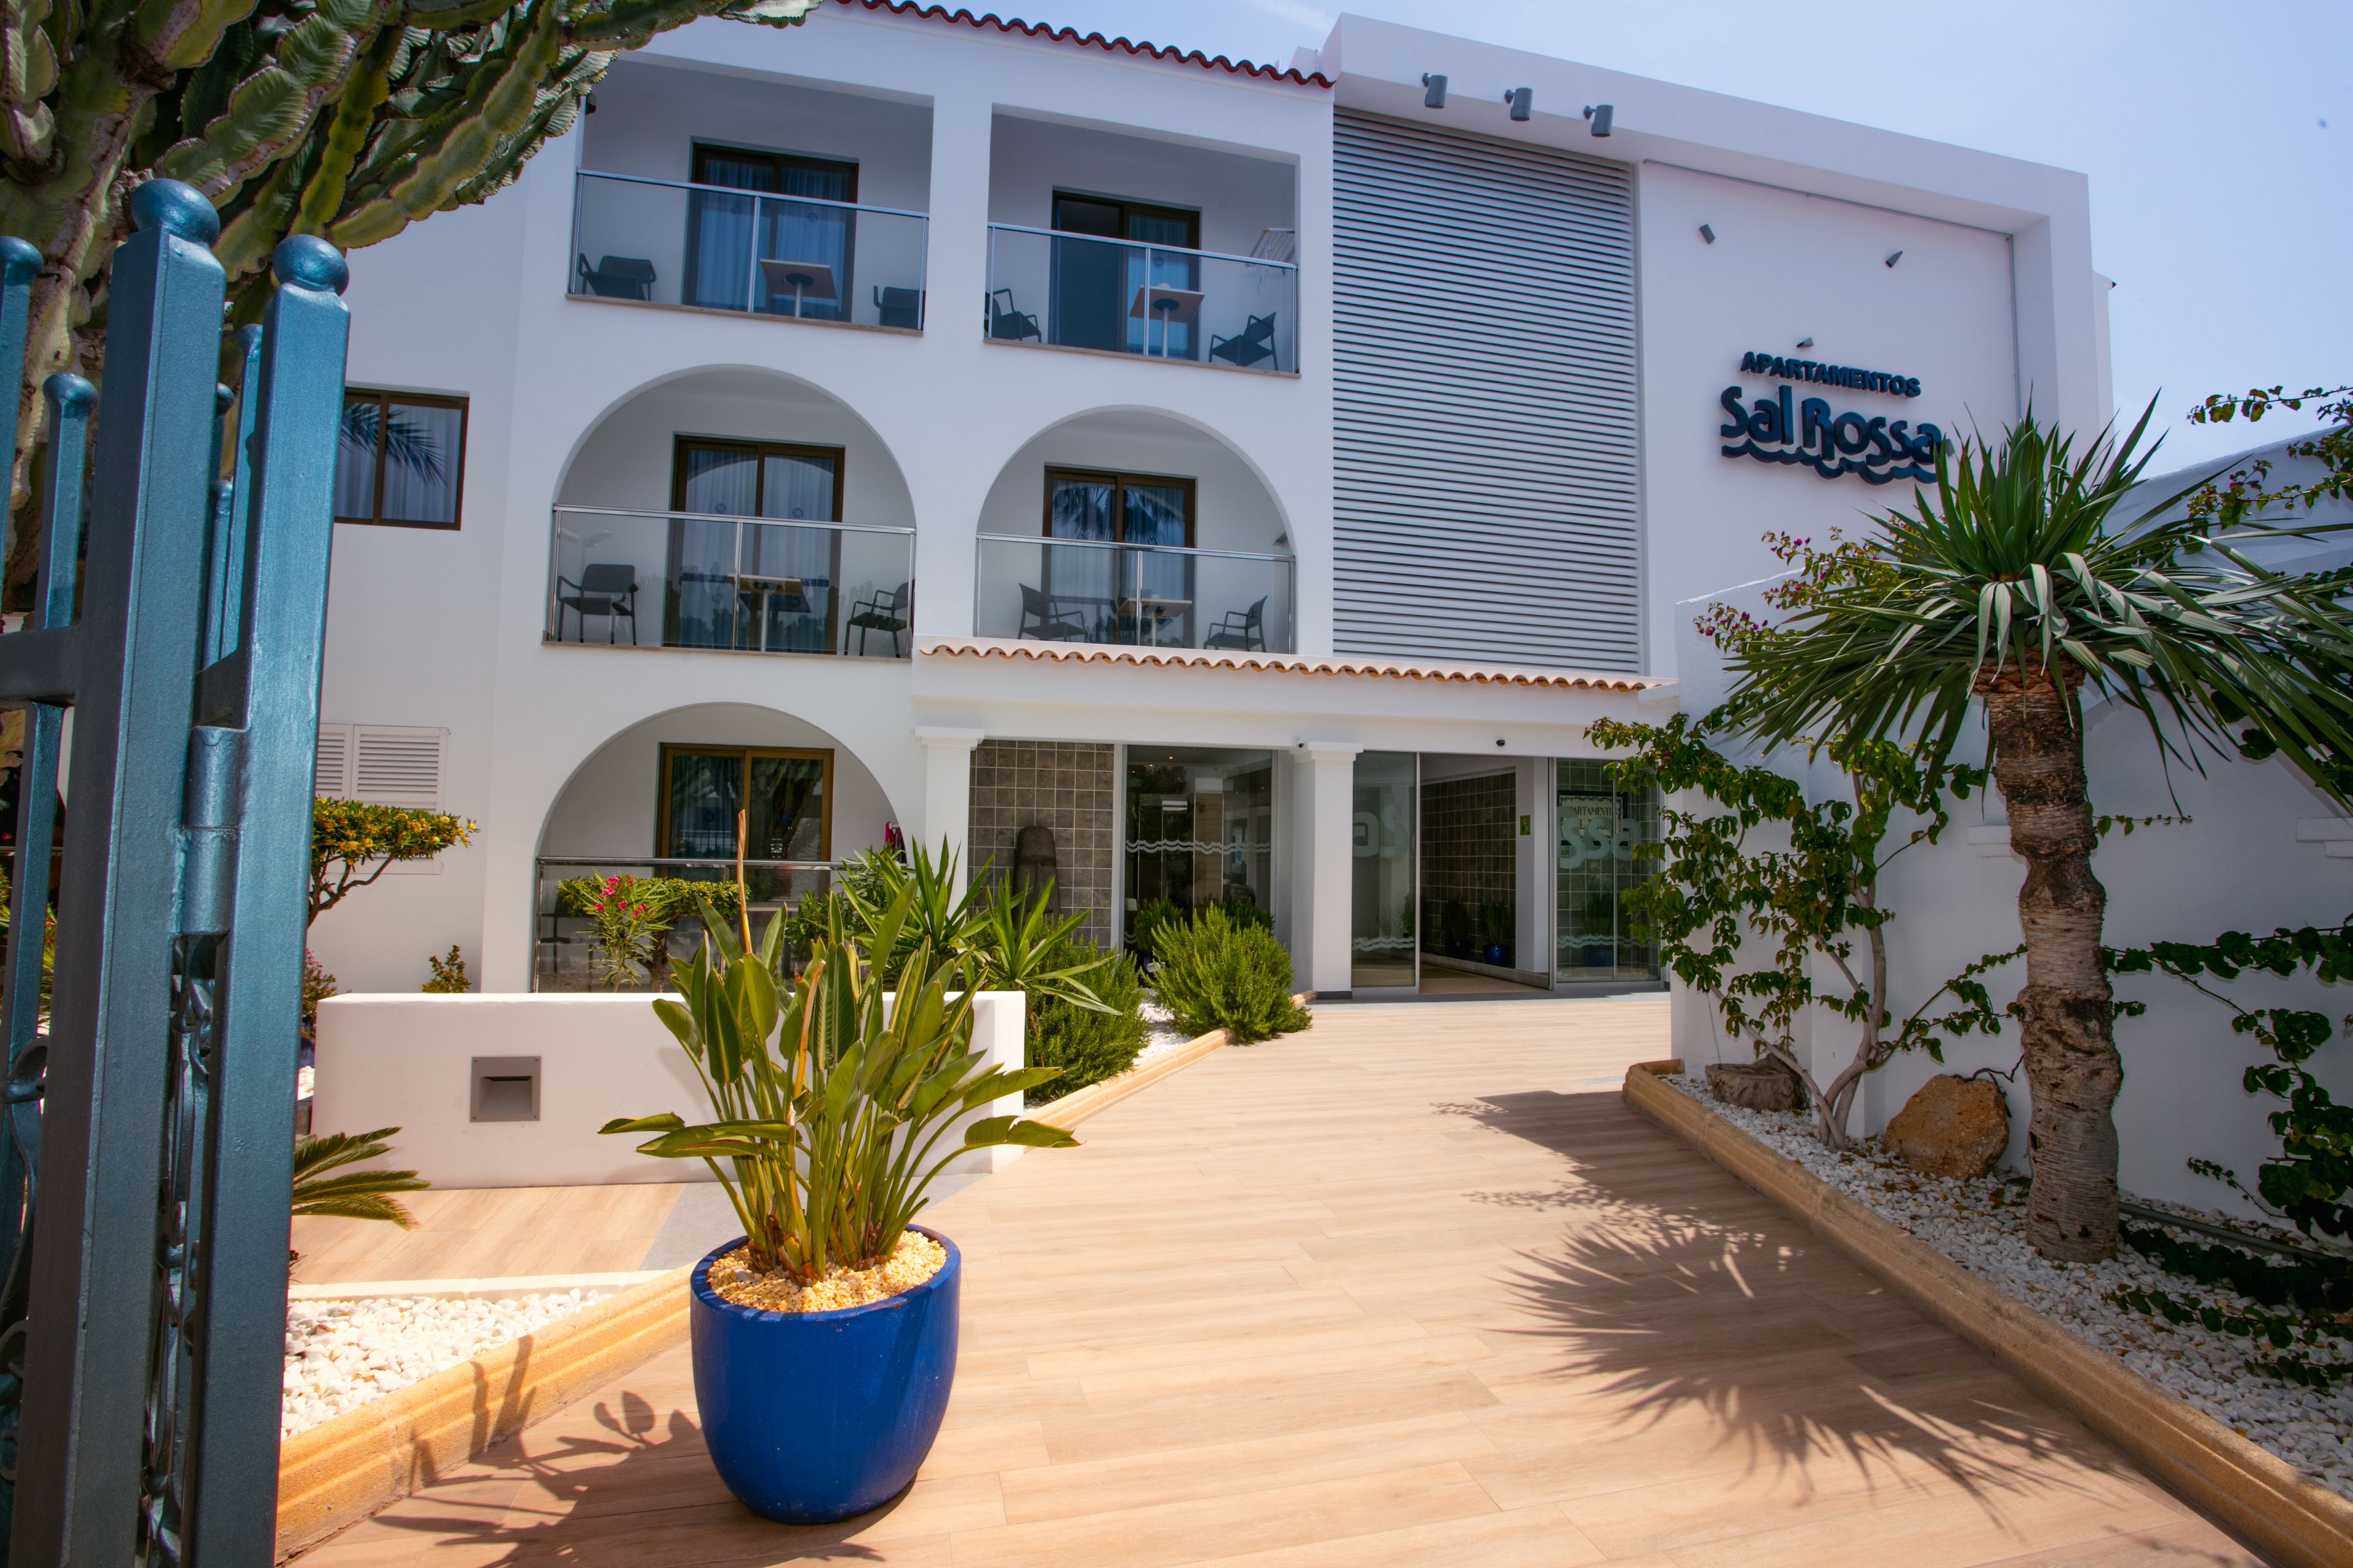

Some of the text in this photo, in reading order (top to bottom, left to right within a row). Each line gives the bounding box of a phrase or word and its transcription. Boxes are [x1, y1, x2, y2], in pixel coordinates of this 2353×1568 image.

[1741, 351, 1921, 398] APARTAMENTOS
[1721, 385, 1942, 466] Sal Rossa
